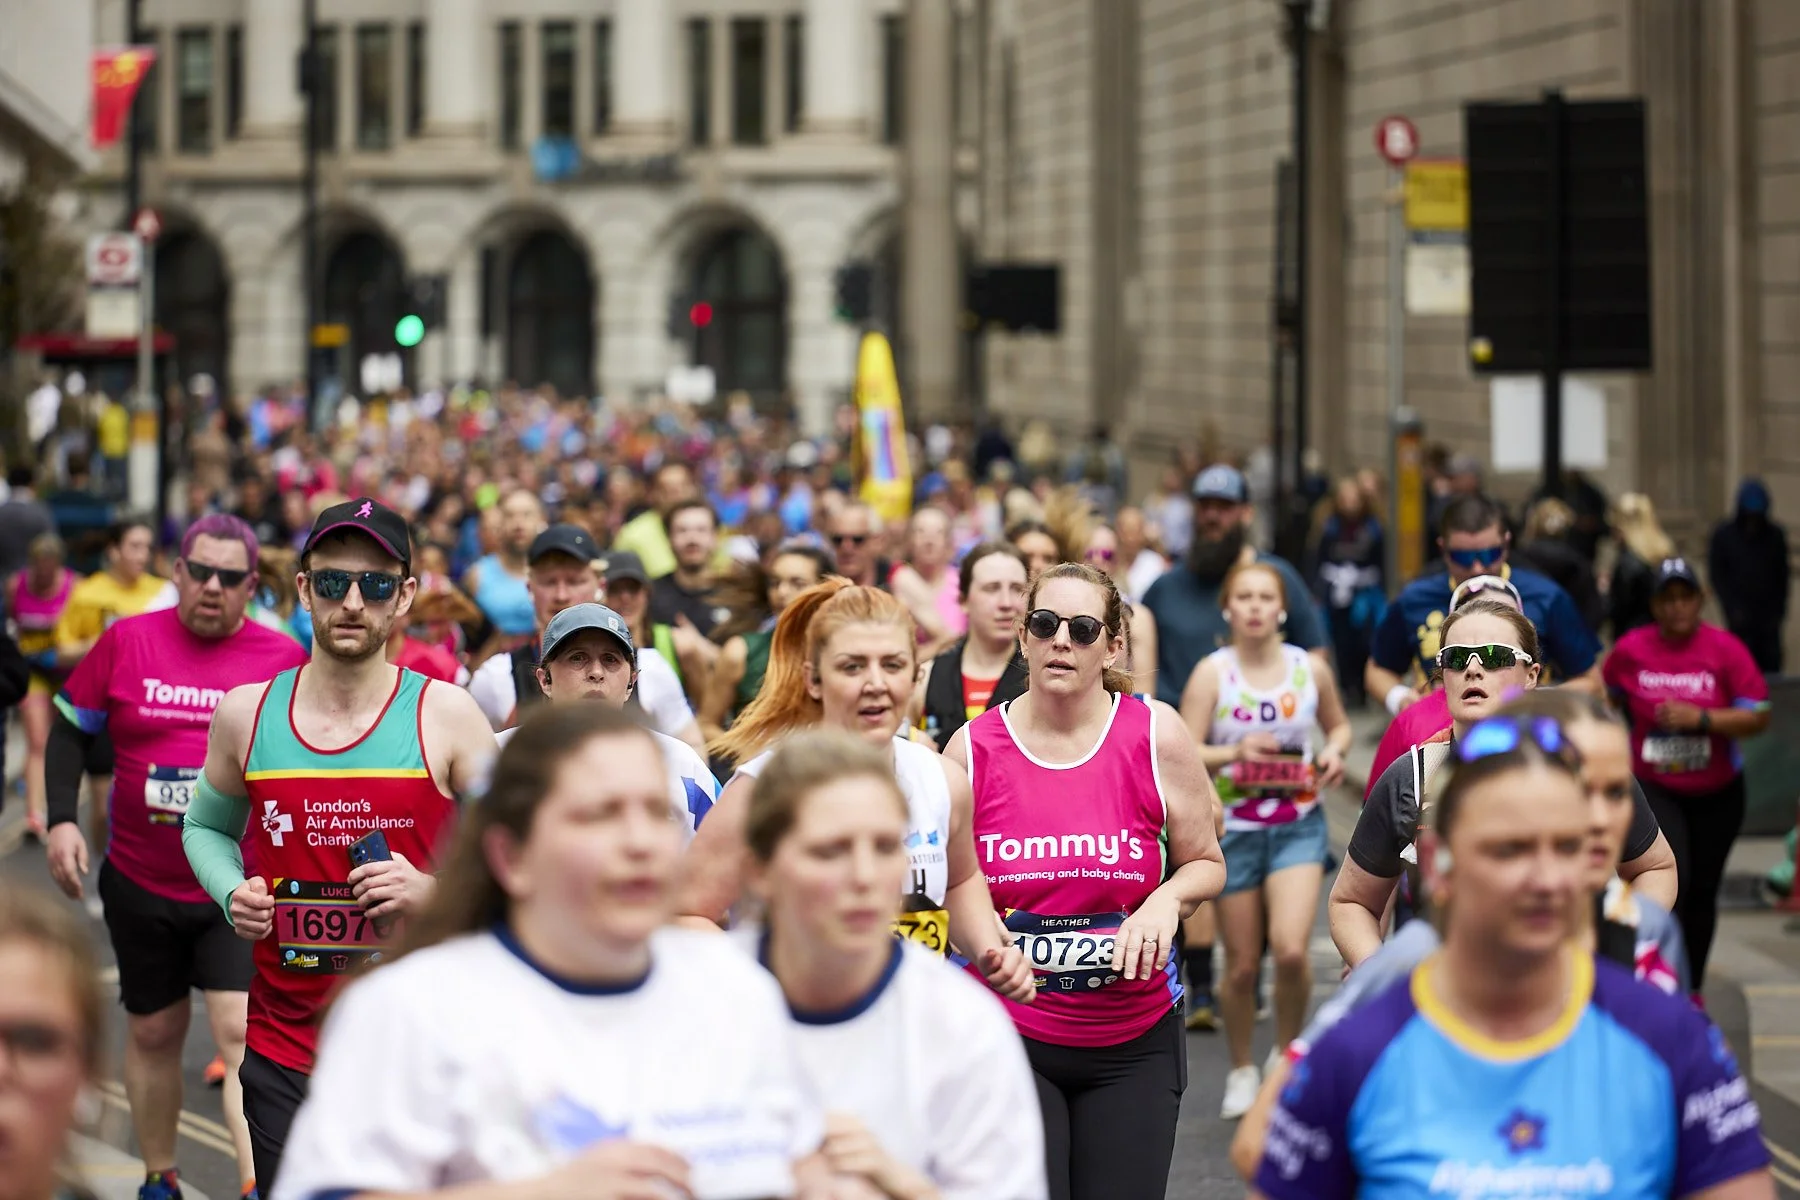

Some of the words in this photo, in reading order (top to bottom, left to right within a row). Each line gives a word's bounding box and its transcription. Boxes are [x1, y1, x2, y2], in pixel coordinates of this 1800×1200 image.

[142, 677, 225, 709] Tomm
[160, 784, 190, 805] 93
[303, 798, 372, 813] London's
[305, 815, 328, 830] Air
[329, 814, 415, 830] Ambulance
[979, 828, 1145, 865] Tommy's
[998, 869, 1055, 884] pregnancy
[1057, 867, 1079, 879] and
[1081, 867, 1111, 880] baby
[1112, 869, 1145, 883] charity
[321, 887, 351, 897] LUKE
[1041, 918, 1091, 927] HEATHER
[1013, 934, 1116, 967] 10723
